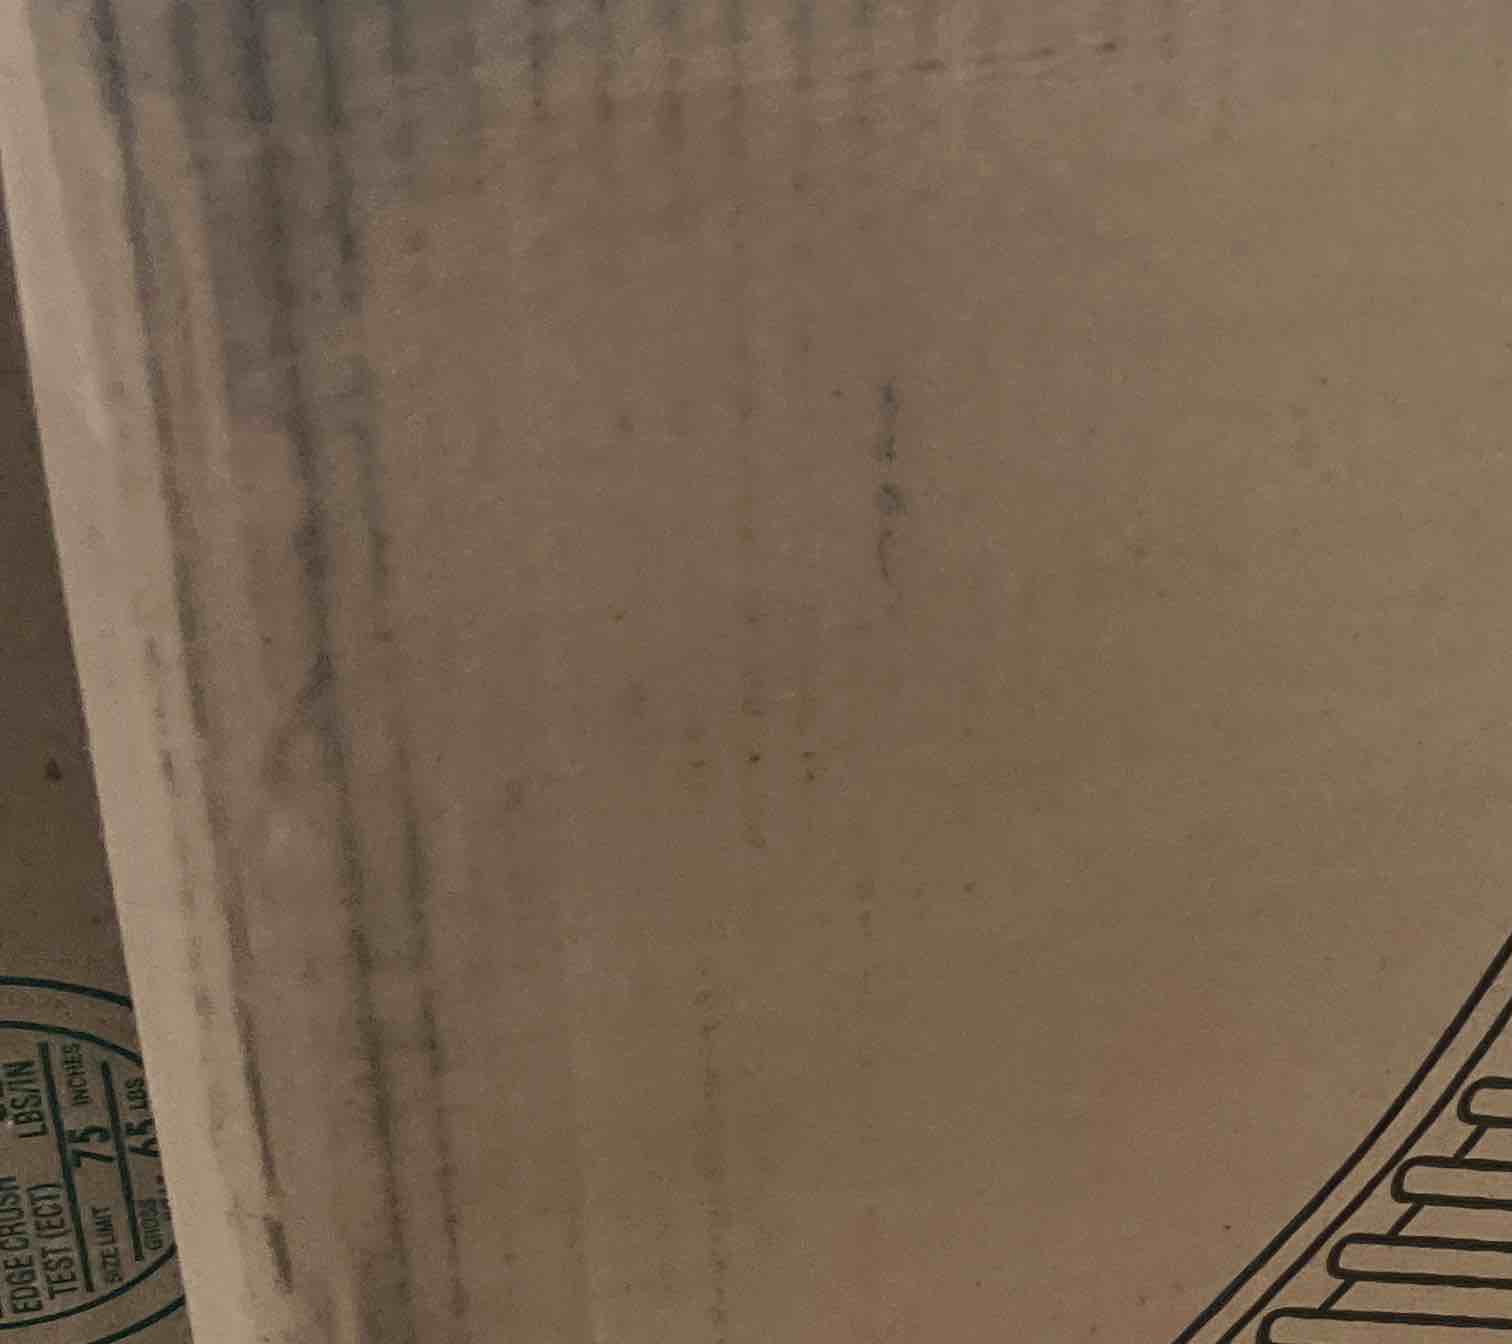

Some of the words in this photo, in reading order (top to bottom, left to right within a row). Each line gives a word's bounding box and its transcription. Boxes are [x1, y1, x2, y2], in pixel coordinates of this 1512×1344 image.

[63, 1042, 90, 1106] INCHES
[127, 1077, 148, 1110] LBS
[66, 1126, 114, 1168] 75
[26, 1184, 72, 1238] (ECT)
[92, 1207, 117, 1246] LIMIT
[3, 1255, 43, 1314] EDGE
[40, 1246, 79, 1299] TEST
[101, 1247, 123, 1283] SIZE
